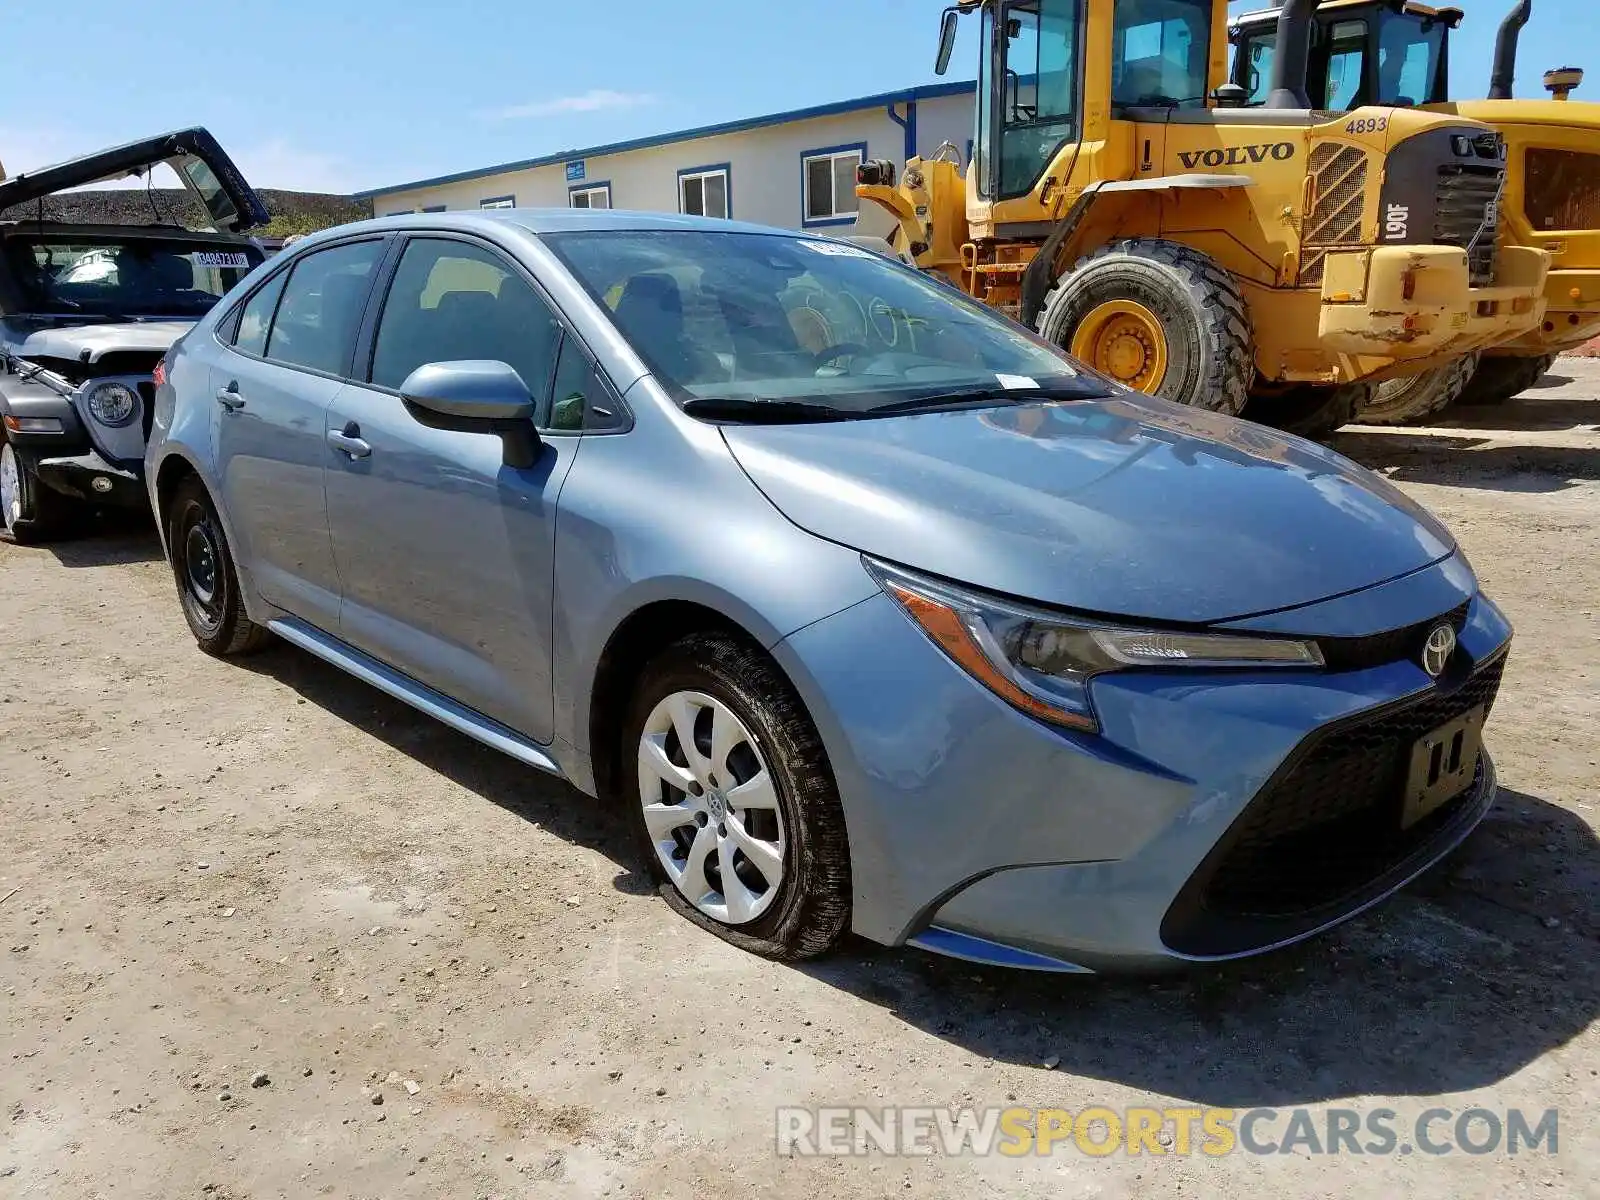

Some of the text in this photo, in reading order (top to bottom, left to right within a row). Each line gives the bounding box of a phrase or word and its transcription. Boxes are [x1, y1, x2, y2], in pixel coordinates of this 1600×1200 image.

[1345, 116, 1388, 135] 4893
[1177, 142, 1296, 170] VOLVO
[1385, 203, 1409, 240] L90F
